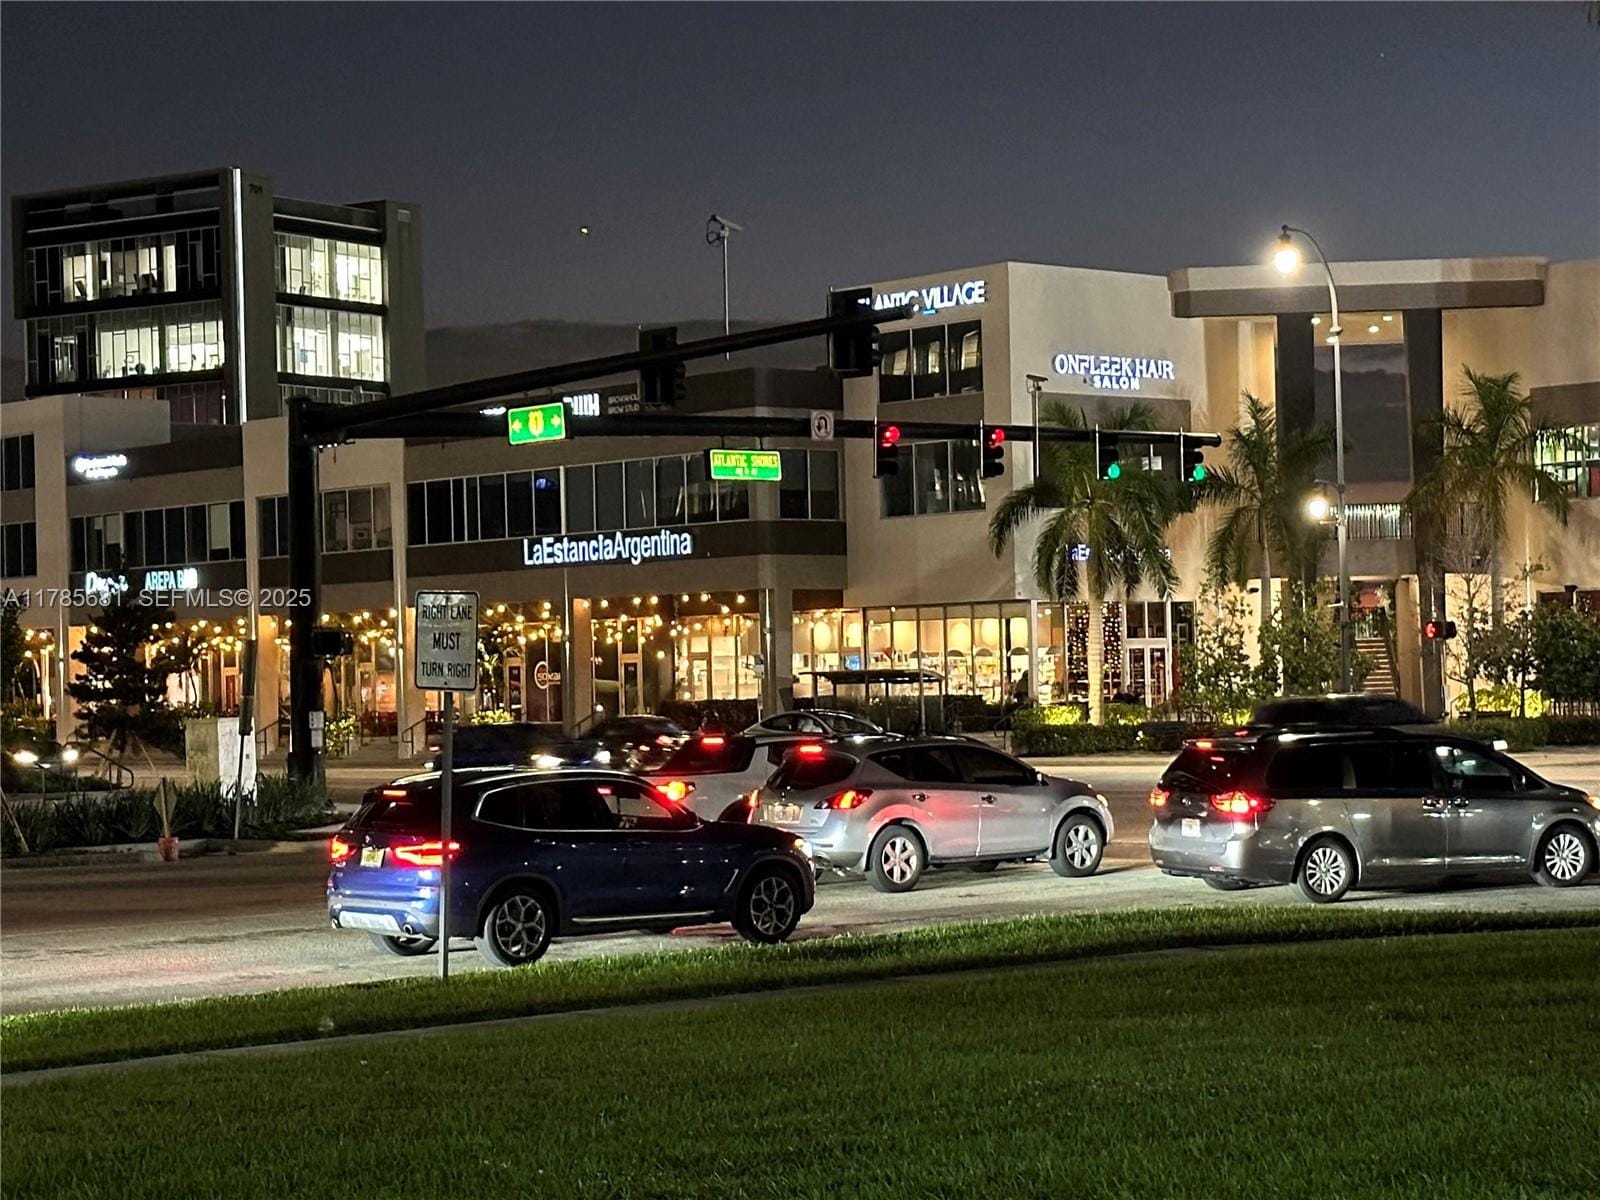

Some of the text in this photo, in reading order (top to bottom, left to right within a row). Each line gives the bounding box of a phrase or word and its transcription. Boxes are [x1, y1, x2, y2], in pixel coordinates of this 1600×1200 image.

[857, 280, 985, 312] ANTIC VILLAGE
[1135, 358, 1175, 380] HAIR
[1093, 375, 1141, 391] SALON
[713, 454, 748, 467] ATLANTIC
[523, 529, 693, 565] LaEstanciaArgentina
[145, 571, 177, 591] AREPA
[422, 605, 473, 620] RIGHT LANE
[432, 632, 461, 650] MUST
[421, 662, 472, 678] TURN RIGHT
